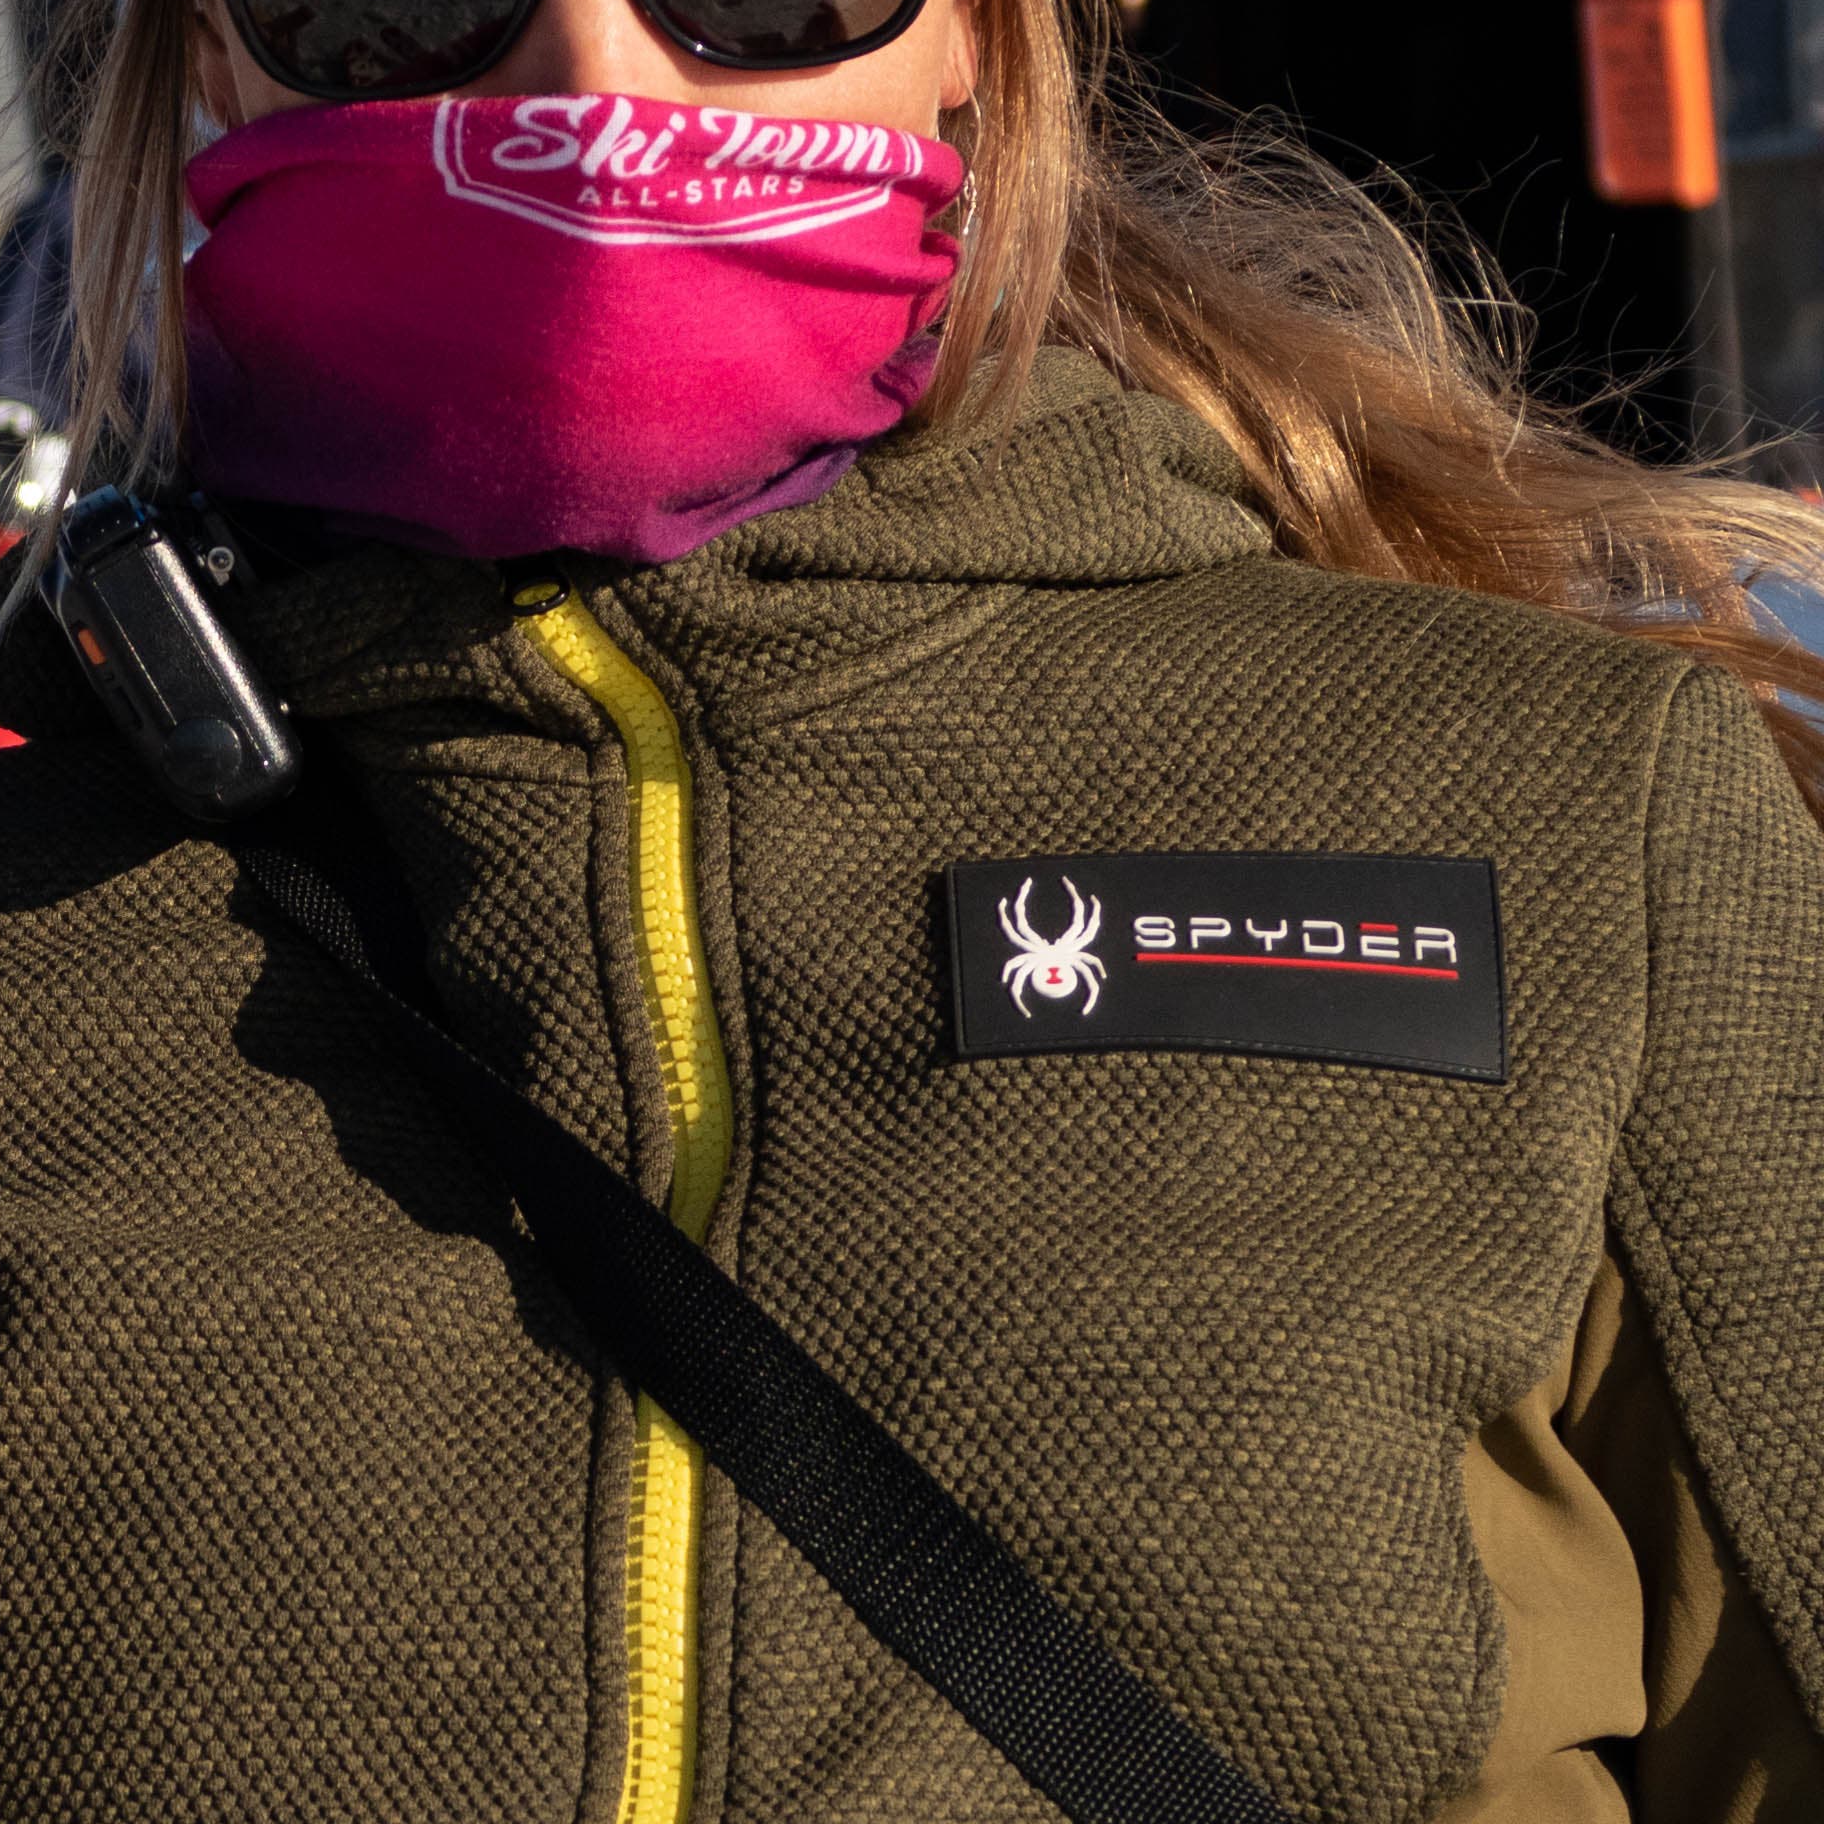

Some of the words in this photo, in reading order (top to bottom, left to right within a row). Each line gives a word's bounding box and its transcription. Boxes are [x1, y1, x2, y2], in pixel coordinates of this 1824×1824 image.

[492, 96, 687, 178] Ski
[699, 107, 893, 174] Town
[577, 175, 806, 207] ALL-STARS
[1133, 915, 1457, 964] SPYDER
